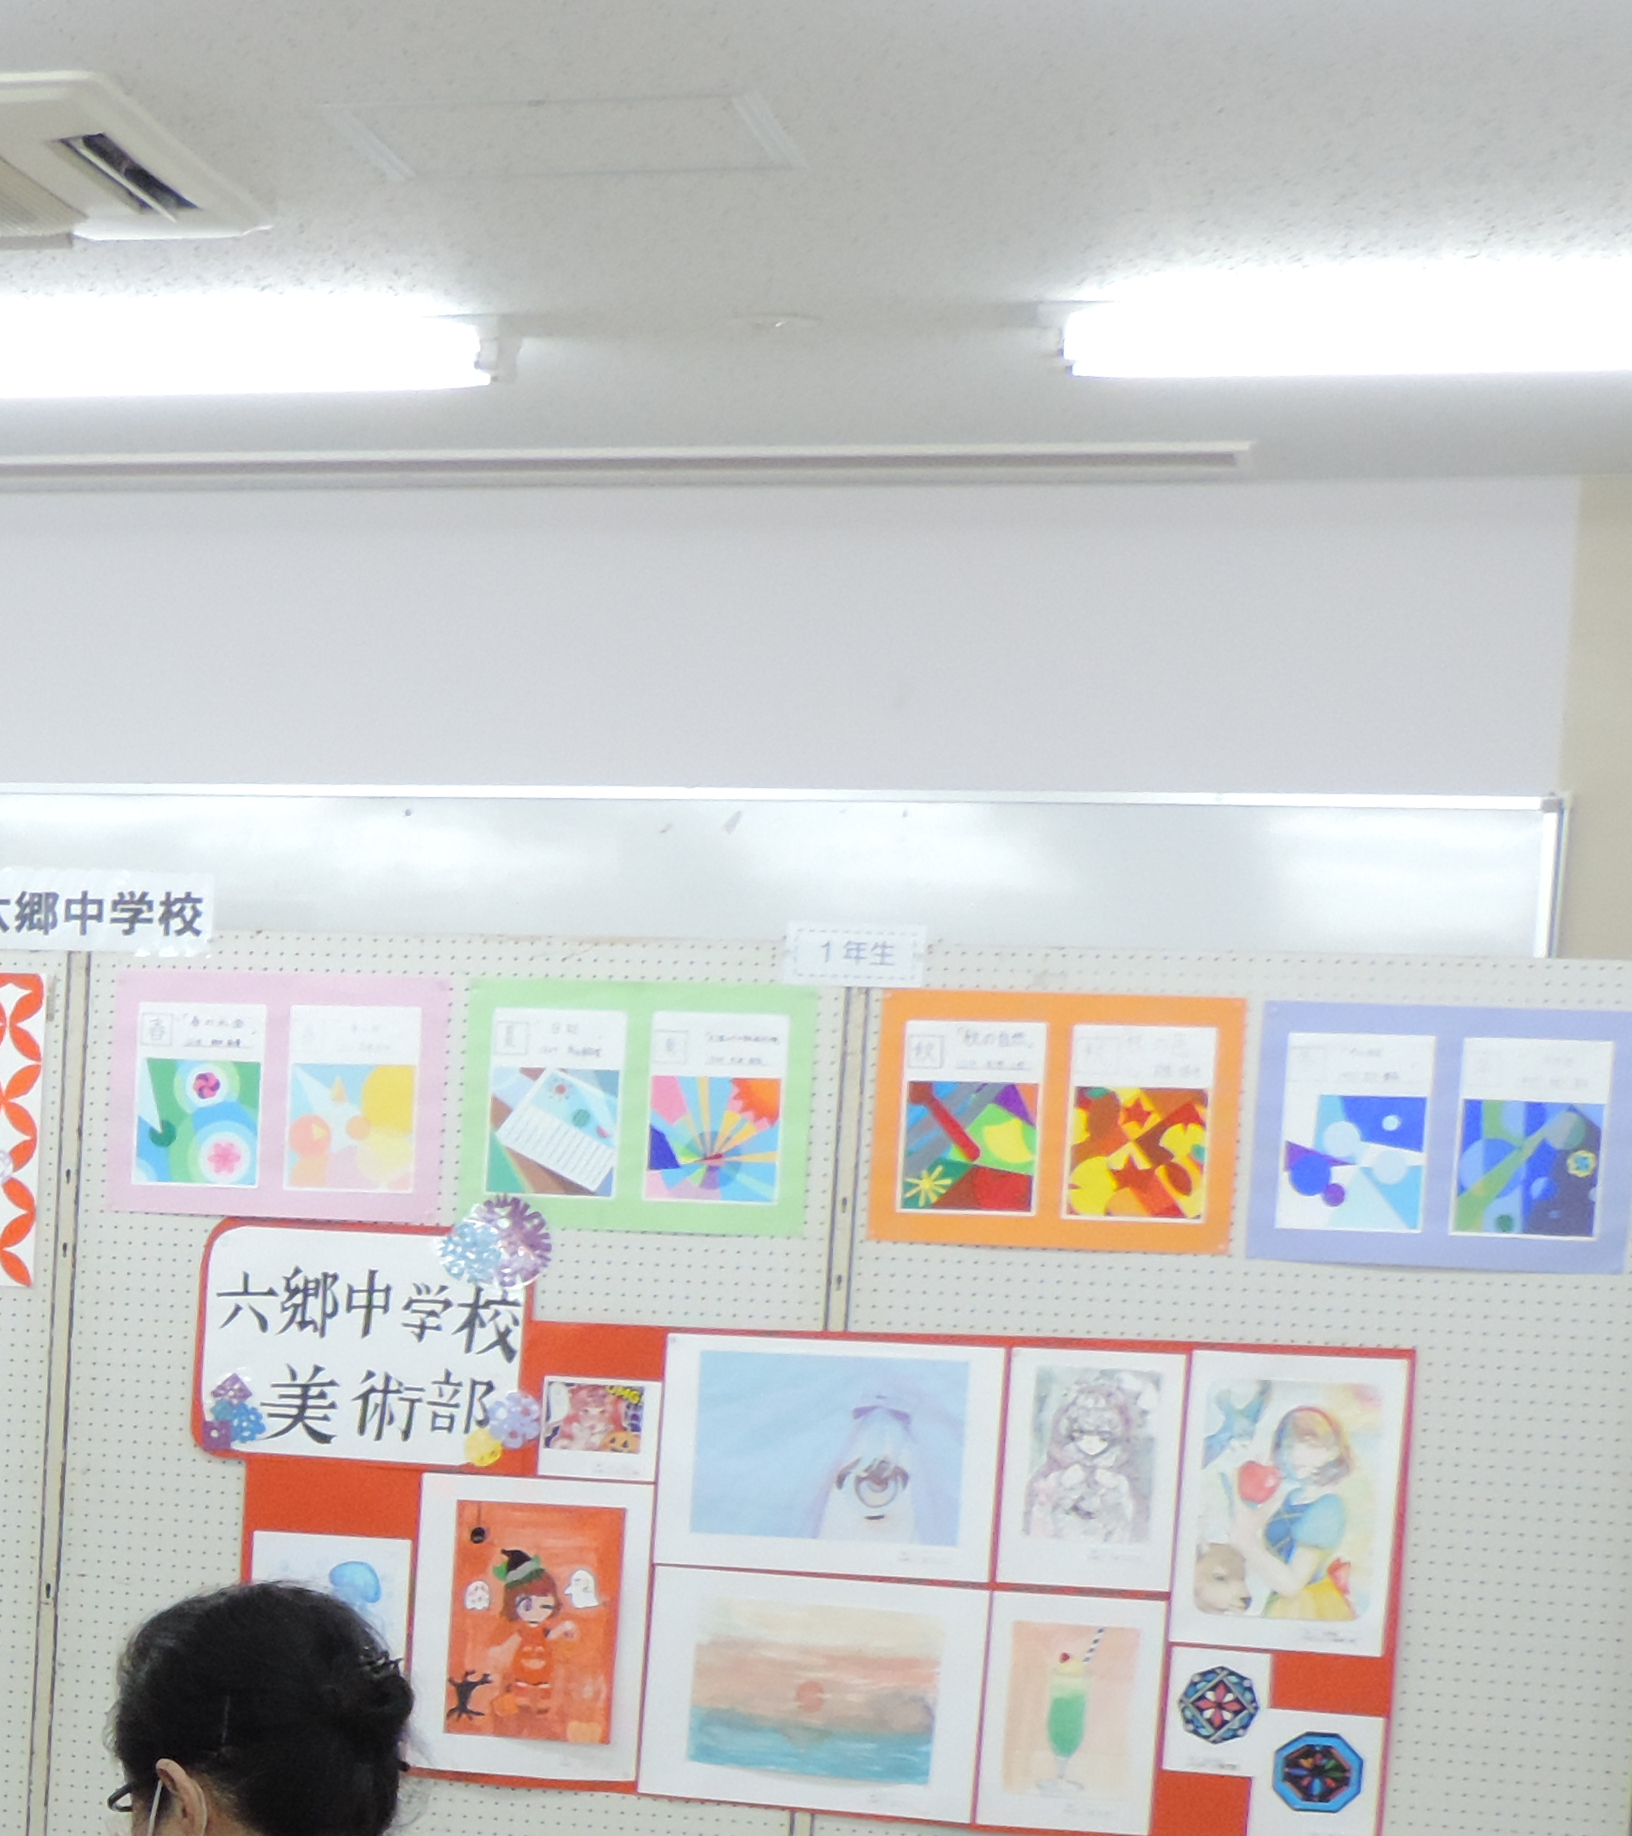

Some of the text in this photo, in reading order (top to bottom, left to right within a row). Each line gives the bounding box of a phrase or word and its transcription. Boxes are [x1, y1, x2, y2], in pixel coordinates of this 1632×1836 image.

[820, 940, 895, 966] 1年生
[216, 1264, 523, 1364] 六郷中学校
[260, 1362, 496, 1445] 美術部
